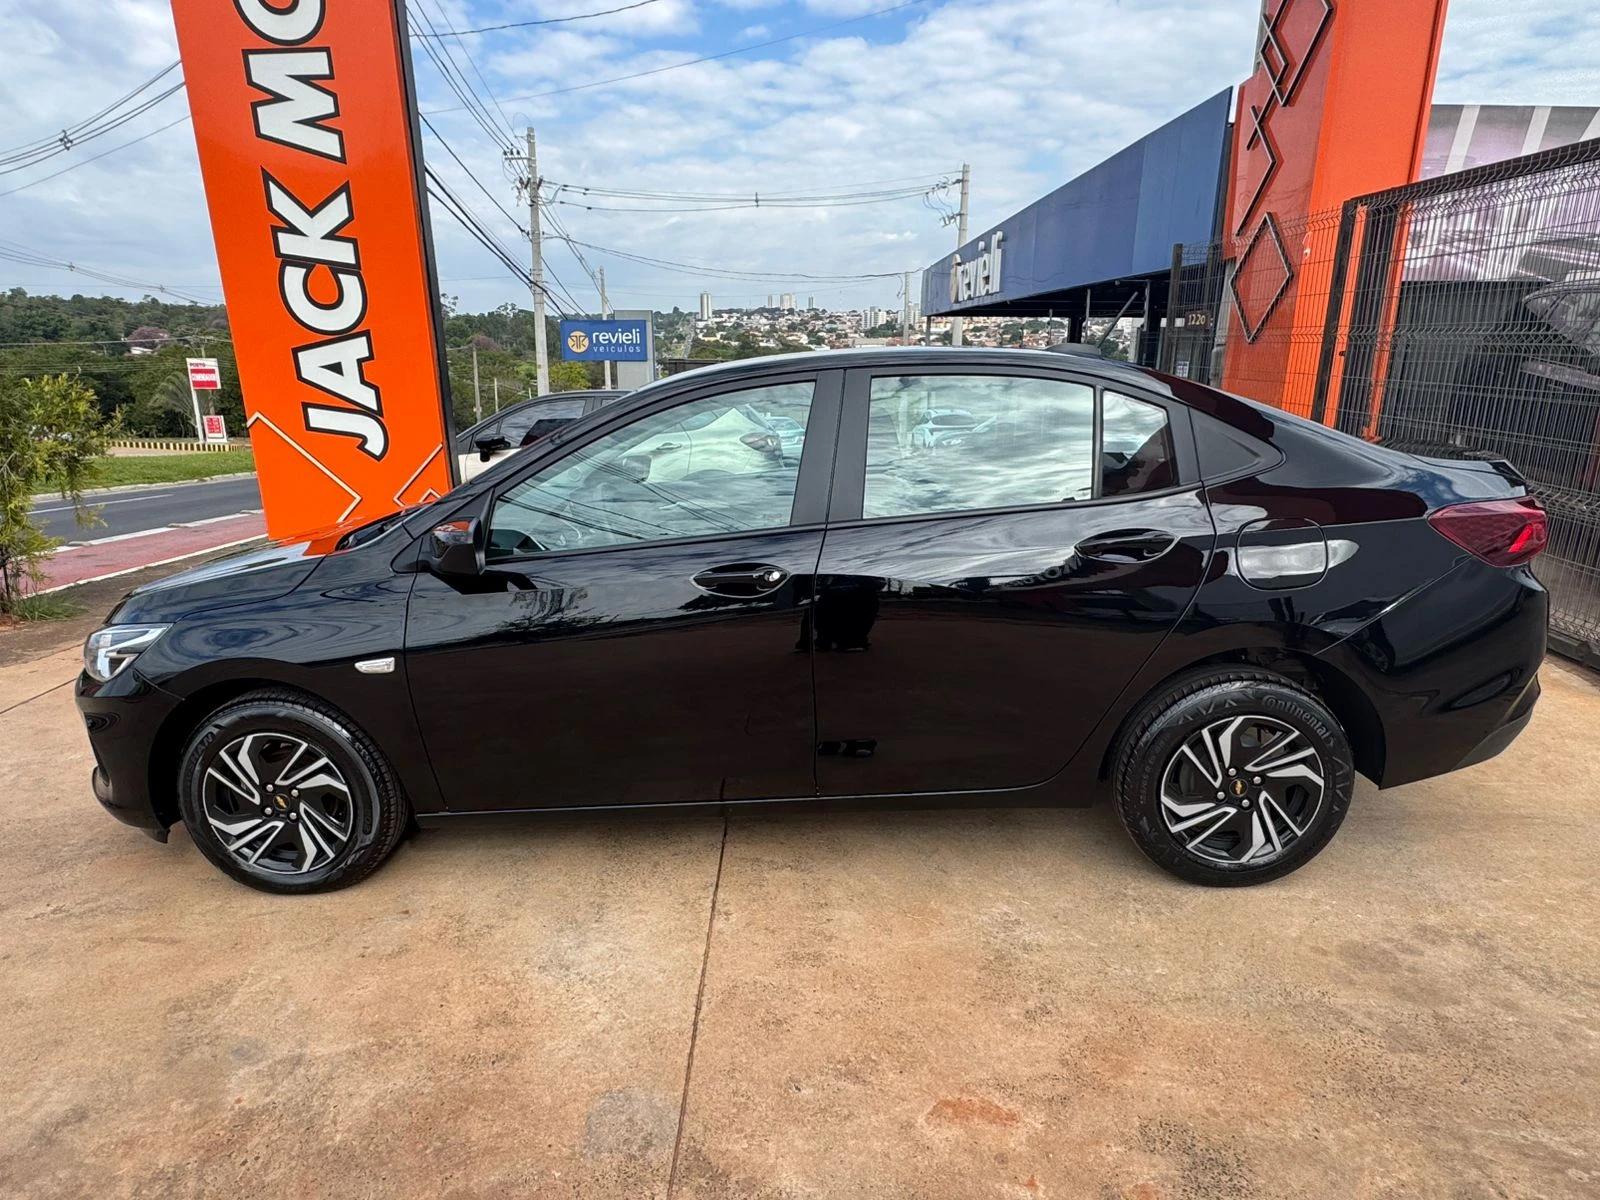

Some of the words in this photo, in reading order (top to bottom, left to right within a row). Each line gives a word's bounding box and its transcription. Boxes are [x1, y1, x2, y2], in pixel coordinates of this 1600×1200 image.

[958, 231, 1003, 301] revieli
[262, 166, 389, 461] JACK
[593, 329, 640, 344] revieli
[1189, 314, 1205, 325] 1220
[1262, 694, 1331, 740] Continental
